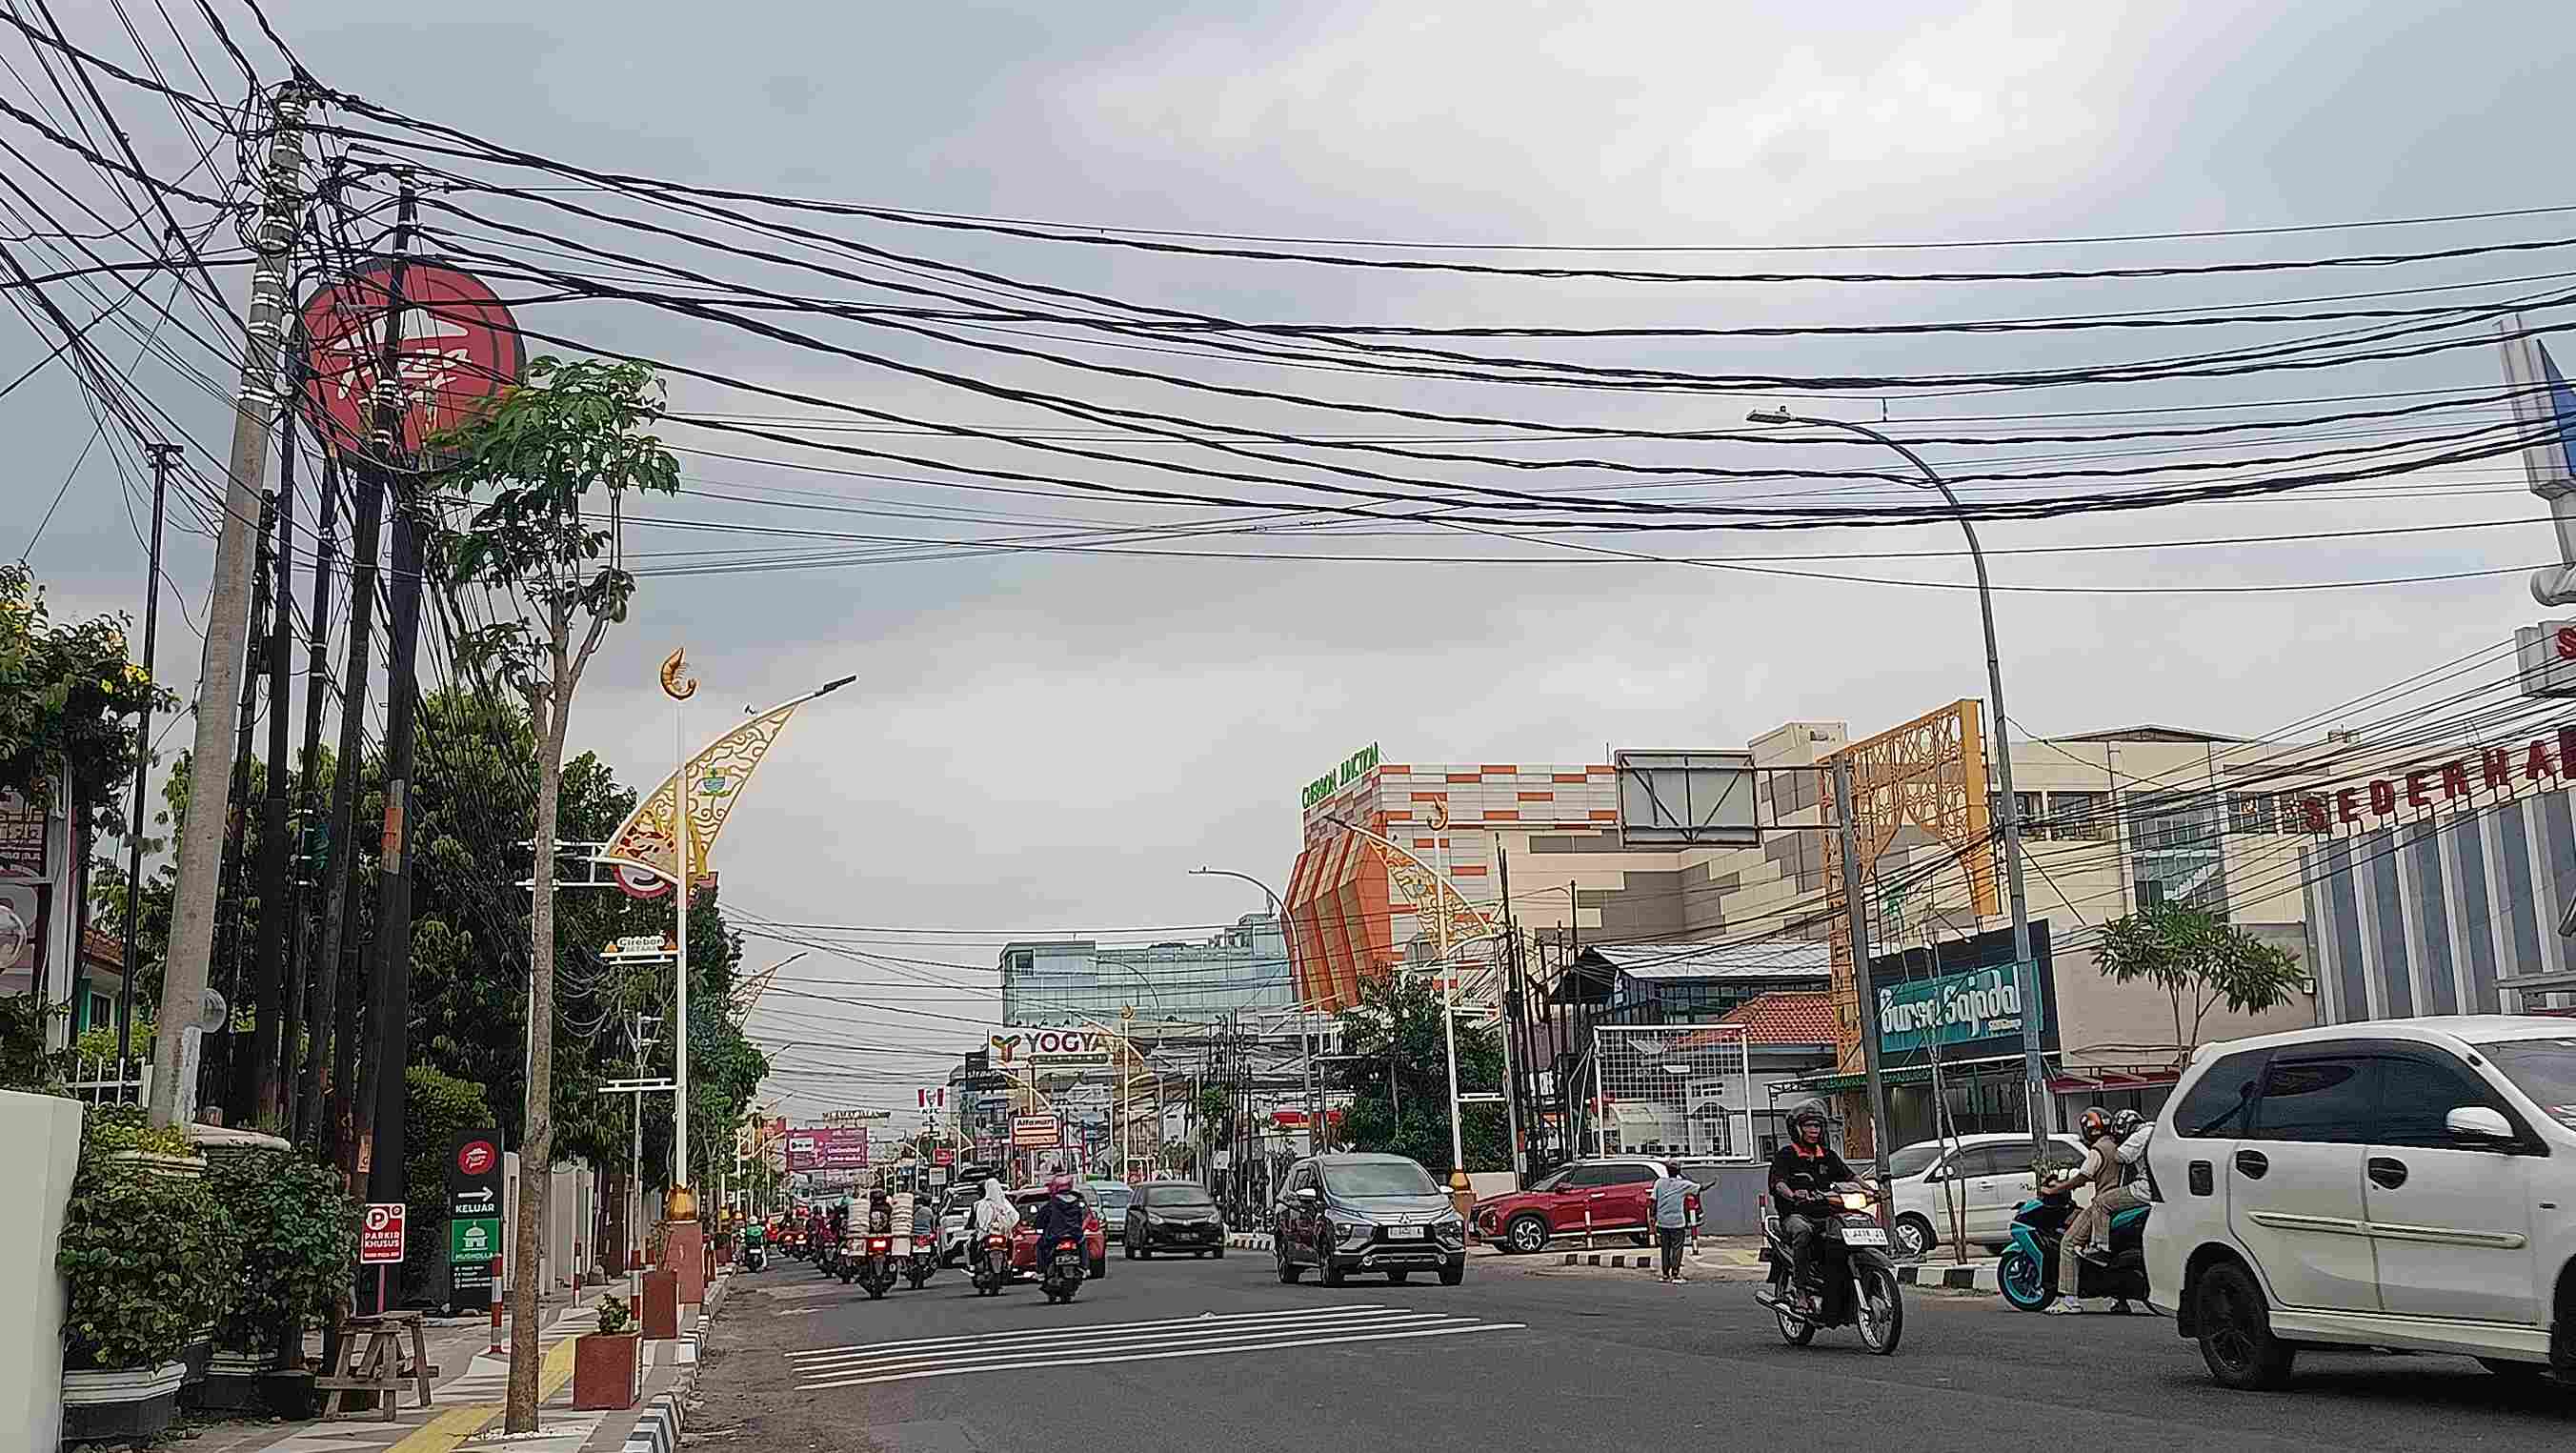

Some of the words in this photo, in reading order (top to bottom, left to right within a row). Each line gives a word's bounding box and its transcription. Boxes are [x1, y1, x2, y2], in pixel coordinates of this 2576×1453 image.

[617, 937, 665, 948] Cirebon
[455, 1203, 494, 1213] KELUAR
[365, 1231, 400, 1241] PARKIR
[364, 1240, 400, 1248] KHUSUS
